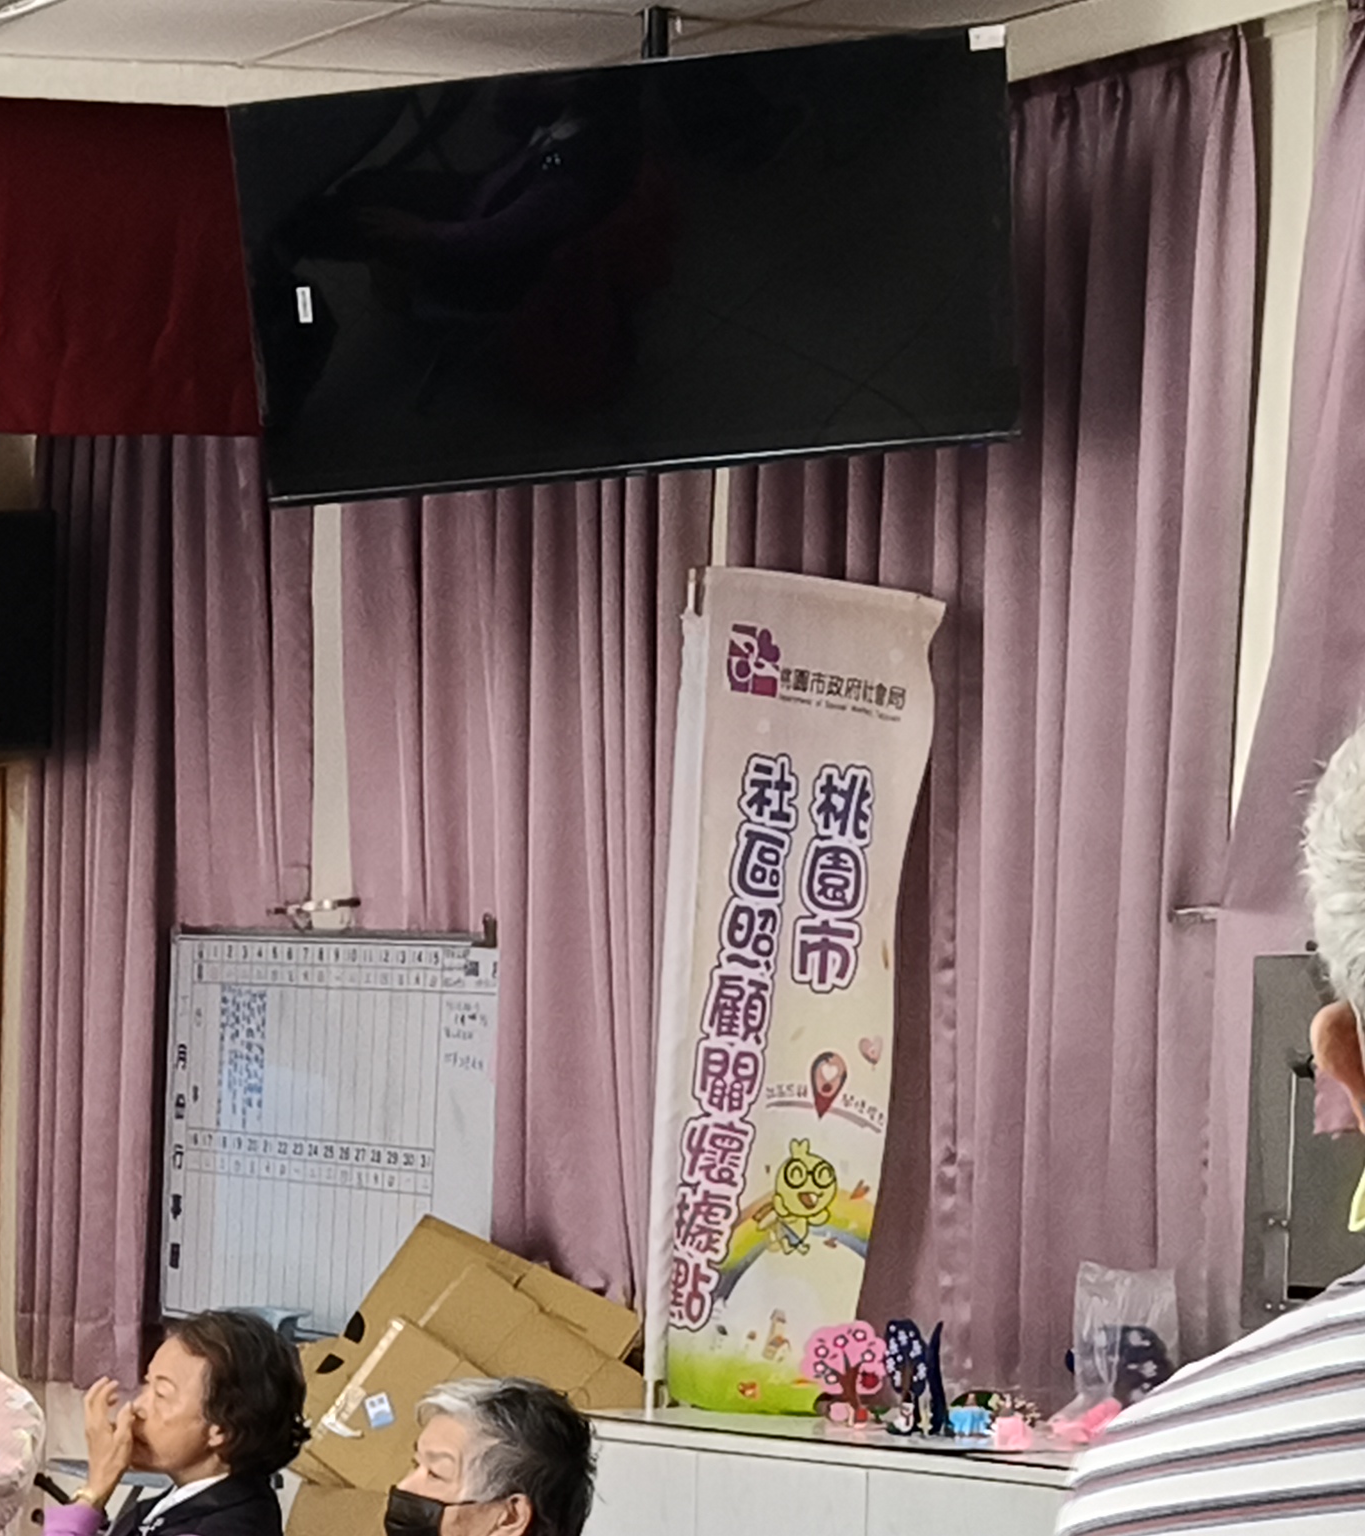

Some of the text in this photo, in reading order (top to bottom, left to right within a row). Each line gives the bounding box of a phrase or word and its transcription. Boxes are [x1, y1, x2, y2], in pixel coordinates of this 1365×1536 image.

[670, 757, 796, 1330] 社區照顧關懷據點
[795, 768, 873, 990] 桃園市
